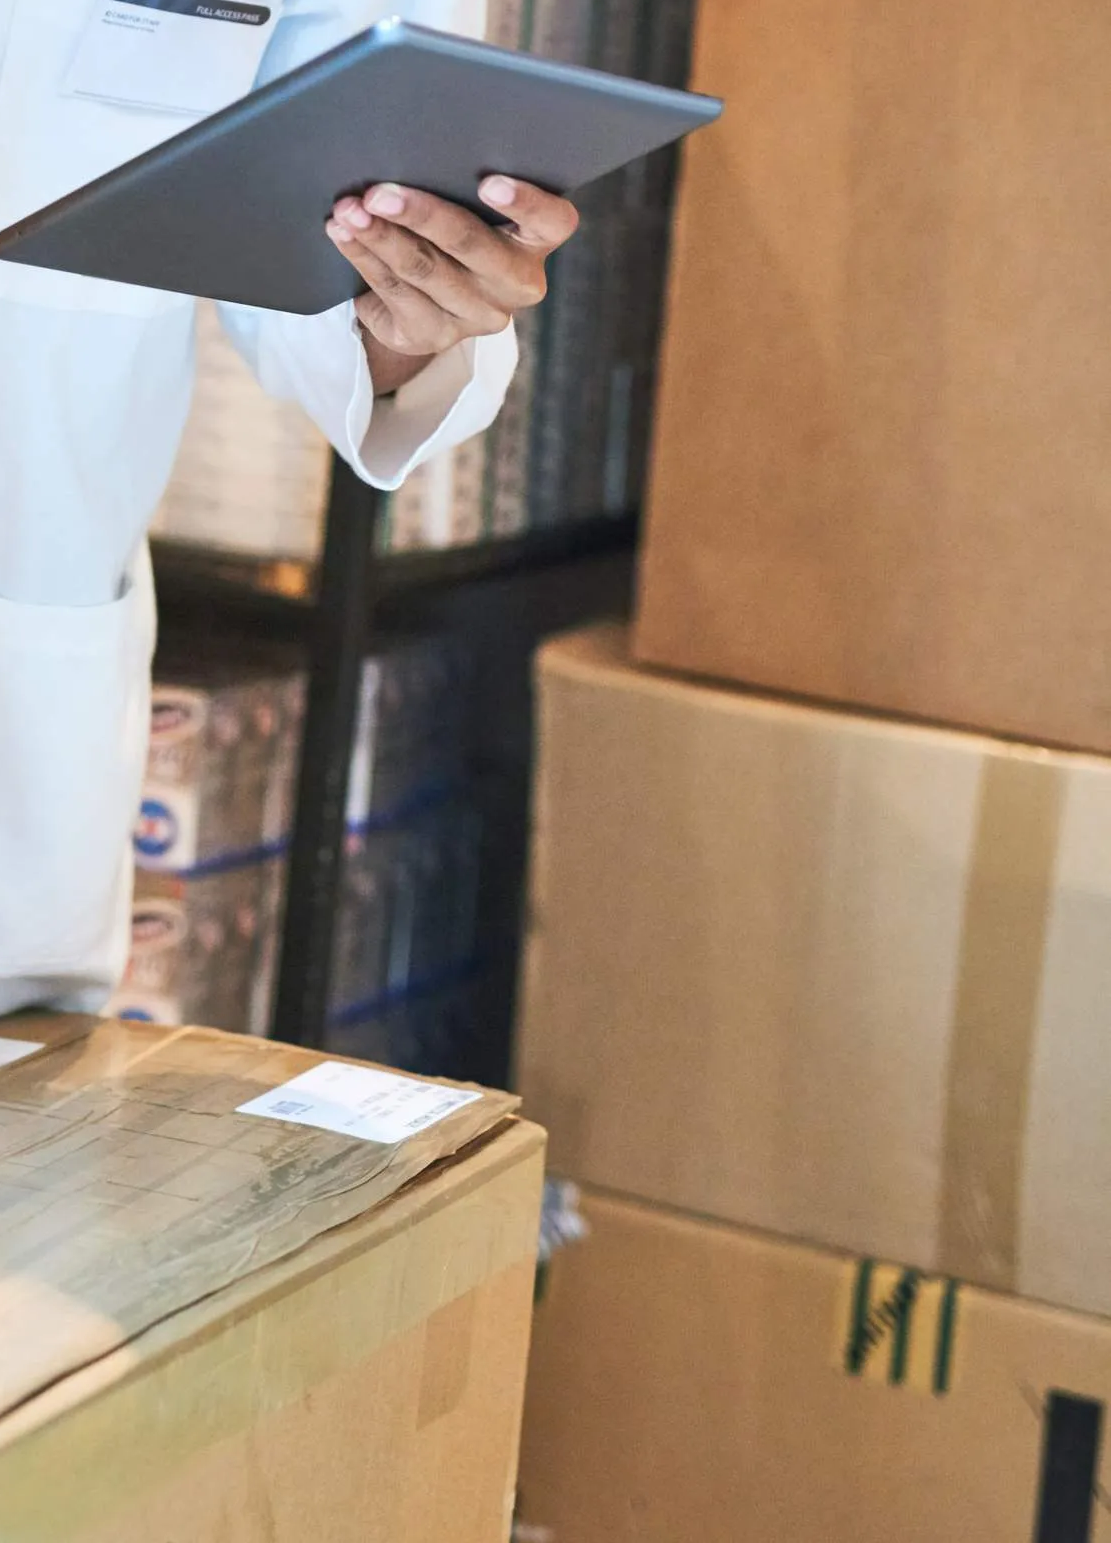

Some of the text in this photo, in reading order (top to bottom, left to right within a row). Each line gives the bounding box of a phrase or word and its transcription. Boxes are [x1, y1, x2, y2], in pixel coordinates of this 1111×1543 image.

[196, 4, 261, 24] FULL ACCESS PASS
